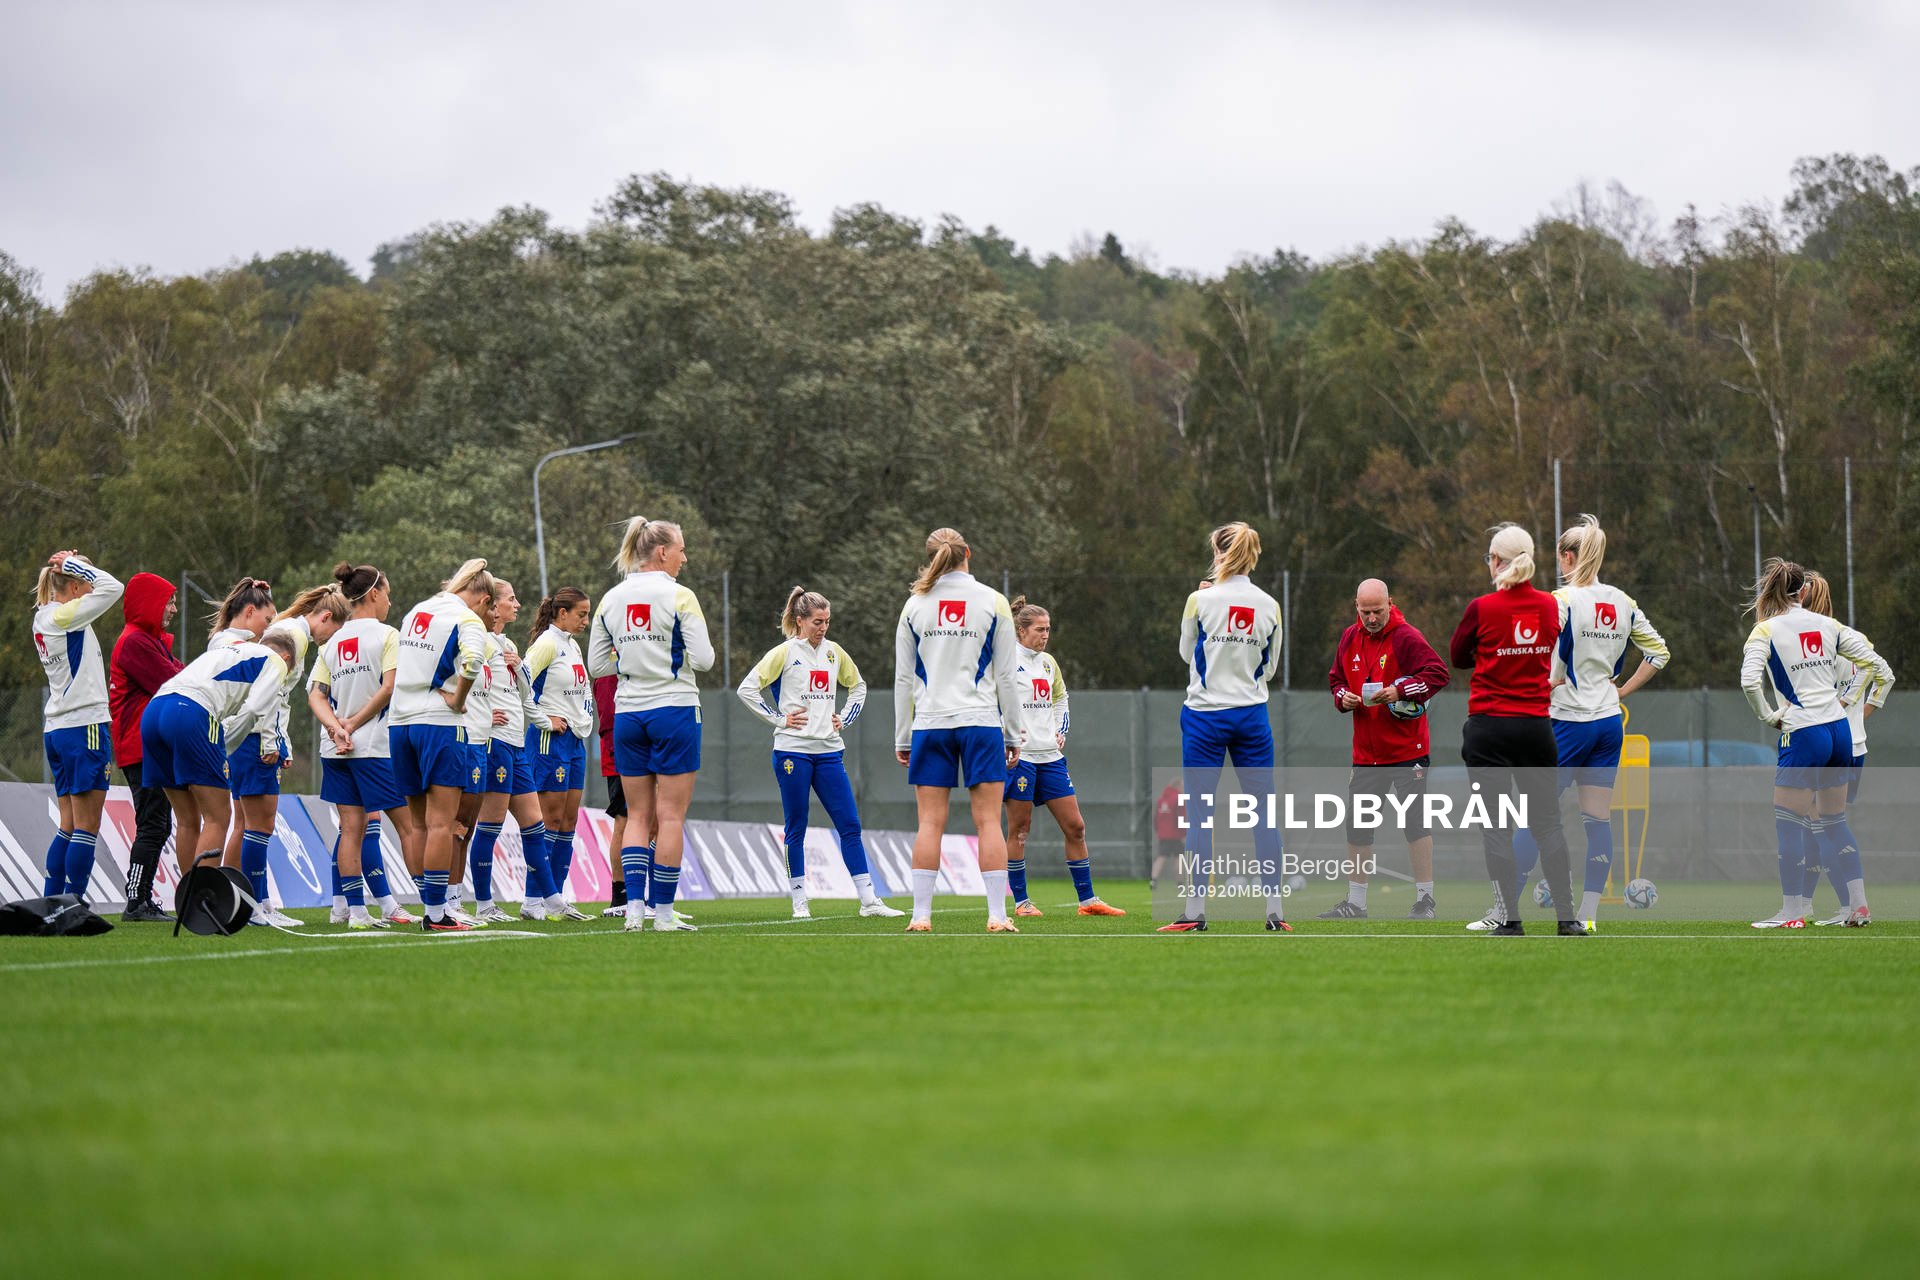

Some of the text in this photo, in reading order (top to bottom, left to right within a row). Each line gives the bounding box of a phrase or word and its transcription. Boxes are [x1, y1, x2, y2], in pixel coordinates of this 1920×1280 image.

[924, 629, 978, 638] SVENSKA SPEL
[1581, 630, 1610, 639] SVENSKA
[619, 634, 666, 644] SENSKA SPEL
[1211, 635, 1244, 643] SVENSKA
[420, 642, 435, 652] SPEL
[1497, 646, 1550, 656] SVENSKA SPEL
[1791, 659, 1821, 671] SVENSKA
